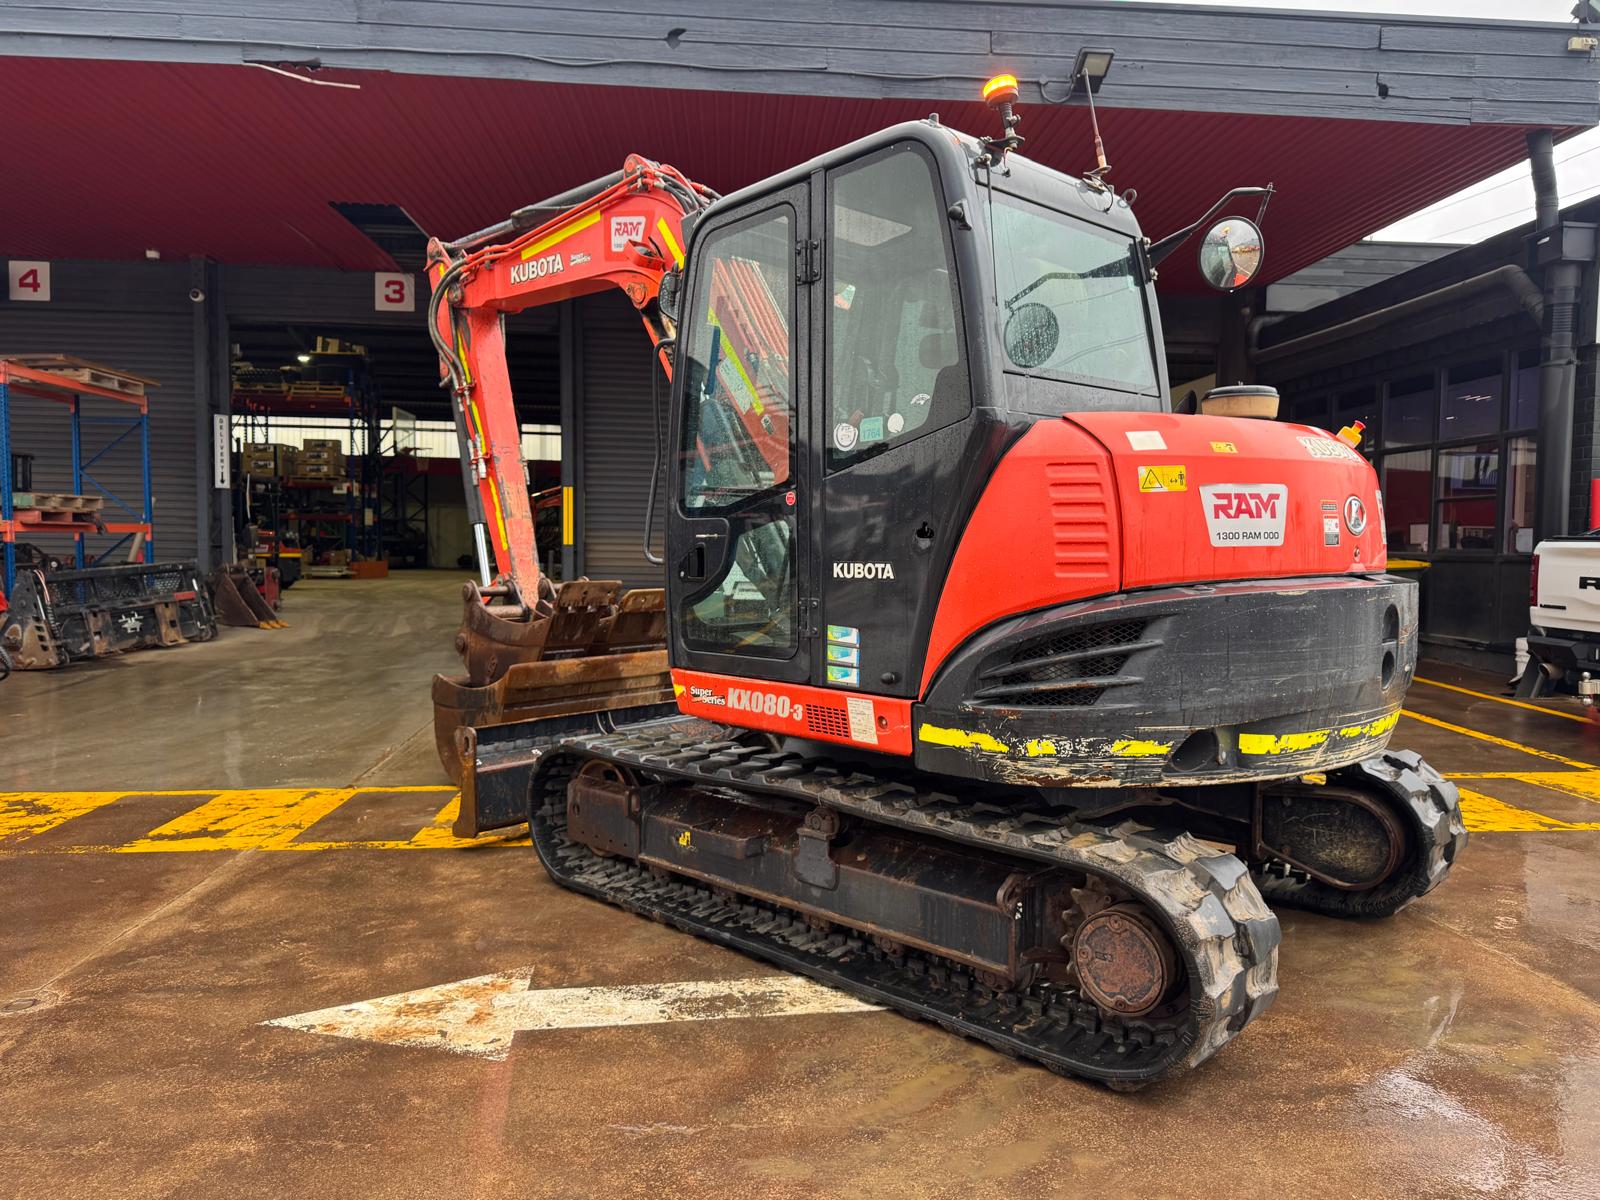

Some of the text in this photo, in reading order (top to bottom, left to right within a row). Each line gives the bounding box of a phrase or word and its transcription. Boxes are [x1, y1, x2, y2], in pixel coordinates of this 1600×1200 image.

[613, 221, 642, 237] RAM
[510, 253, 564, 284] KUBOTA
[18, 268, 41, 293] 4
[384, 280, 405, 304] 3
[1212, 493, 1280, 519] RAM
[1216, 531, 1279, 541] 1300 RAM 000
[833, 562, 895, 579] KUBOTA
[690, 685, 713, 697] Super
[702, 695, 726, 705] Series
[727, 687, 804, 721] KX080-3
